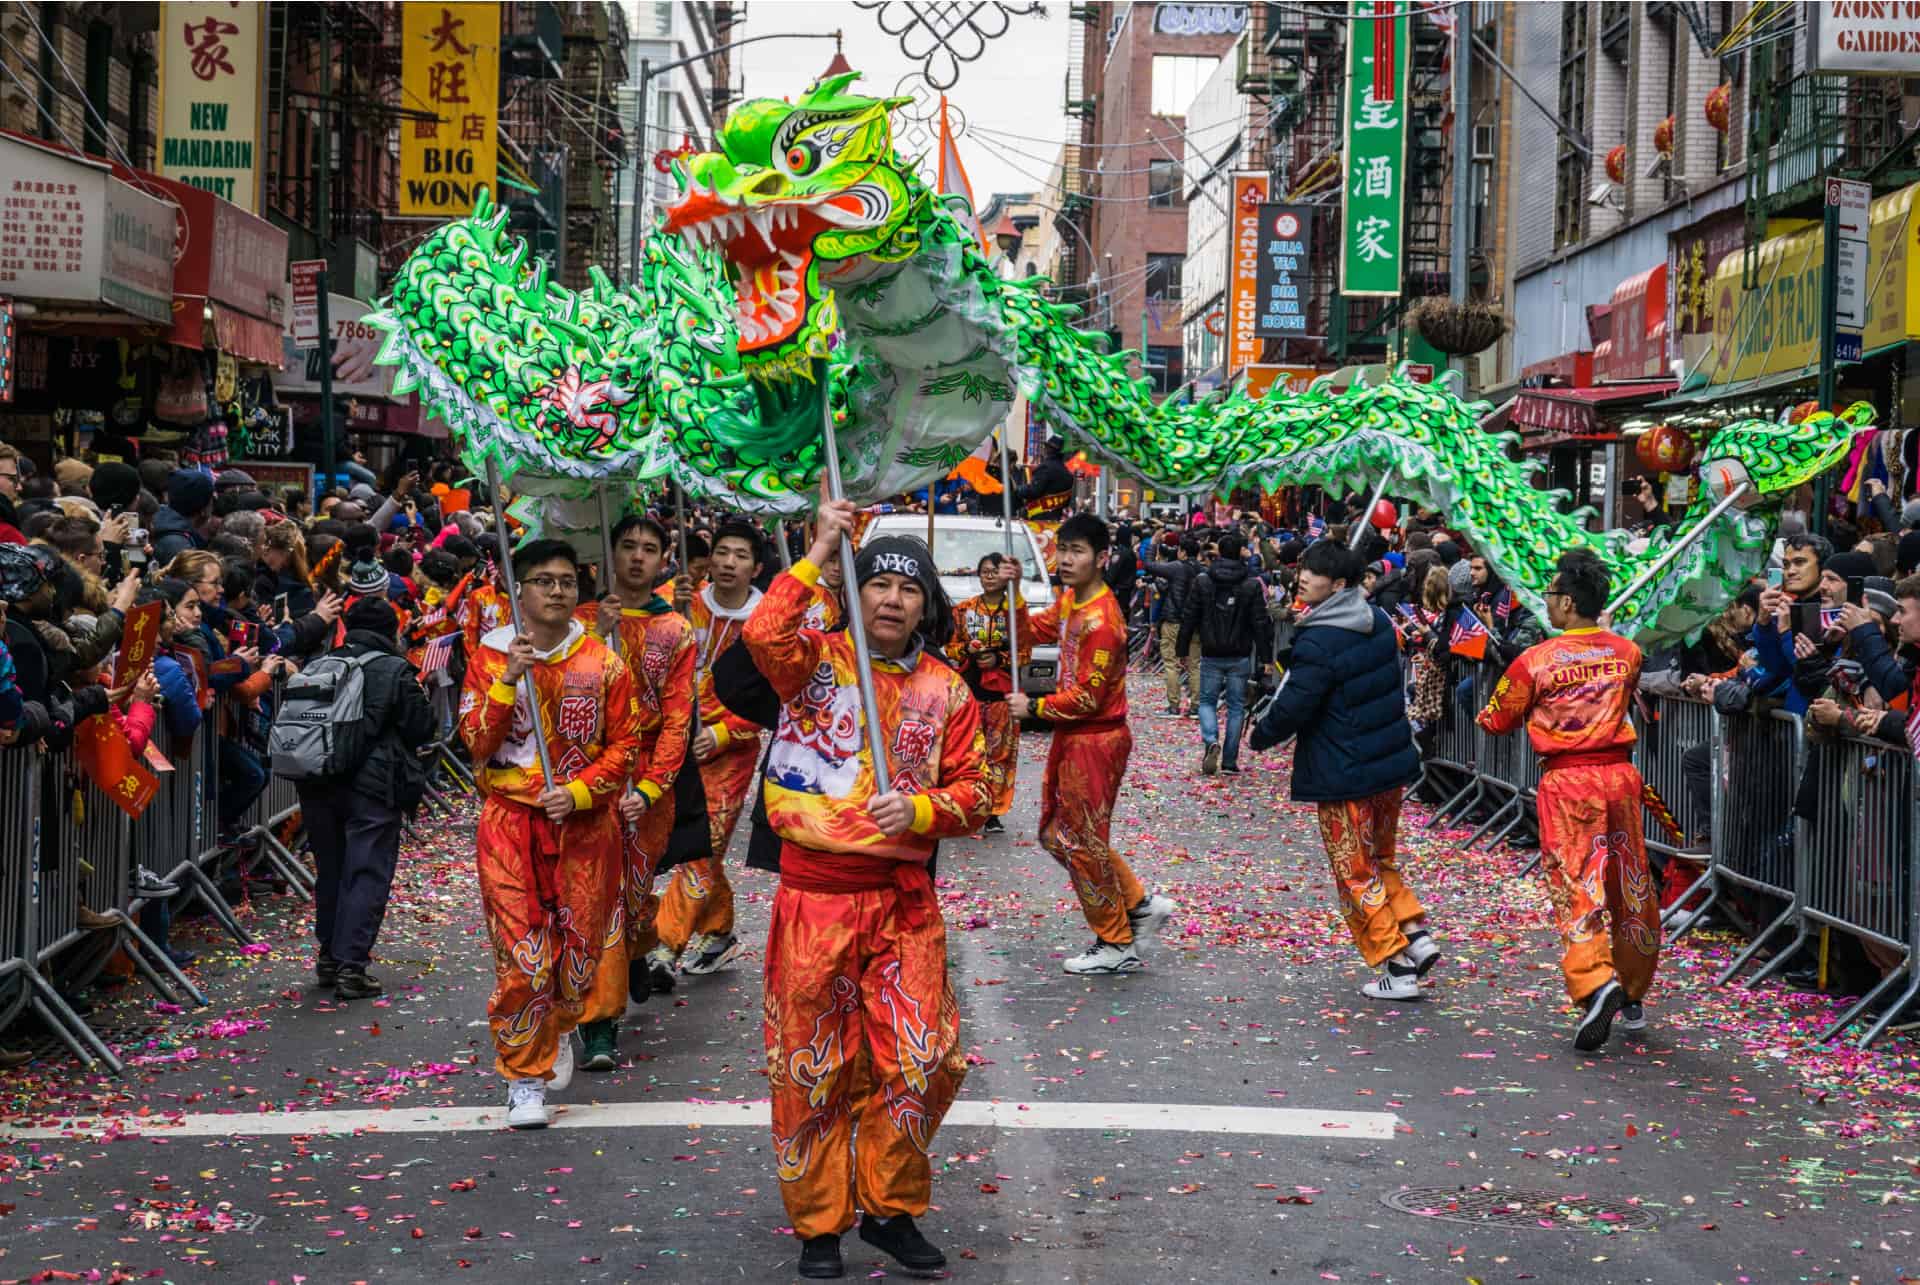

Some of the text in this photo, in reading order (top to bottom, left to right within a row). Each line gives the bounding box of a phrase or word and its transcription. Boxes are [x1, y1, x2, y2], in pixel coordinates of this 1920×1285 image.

[428, 7, 471, 104] 大旺
[190, 102, 228, 131] NEW
[163, 137, 252, 169] MANDARIN
[423, 147, 473, 175] BIG
[1239, 217, 1258, 279] CANTON
[1268, 240, 1304, 255] JULIA
[1273, 256, 1298, 271] TEA
[1278, 270, 1291, 285] &
[1271, 284, 1298, 299] DIM
[1269, 299, 1299, 314] SUM
[1236, 289, 1257, 352] LOUNGE
[1261, 314, 1306, 329] HOUSE
[873, 553, 921, 577] NYC
[1550, 657, 1631, 687] UNITED
